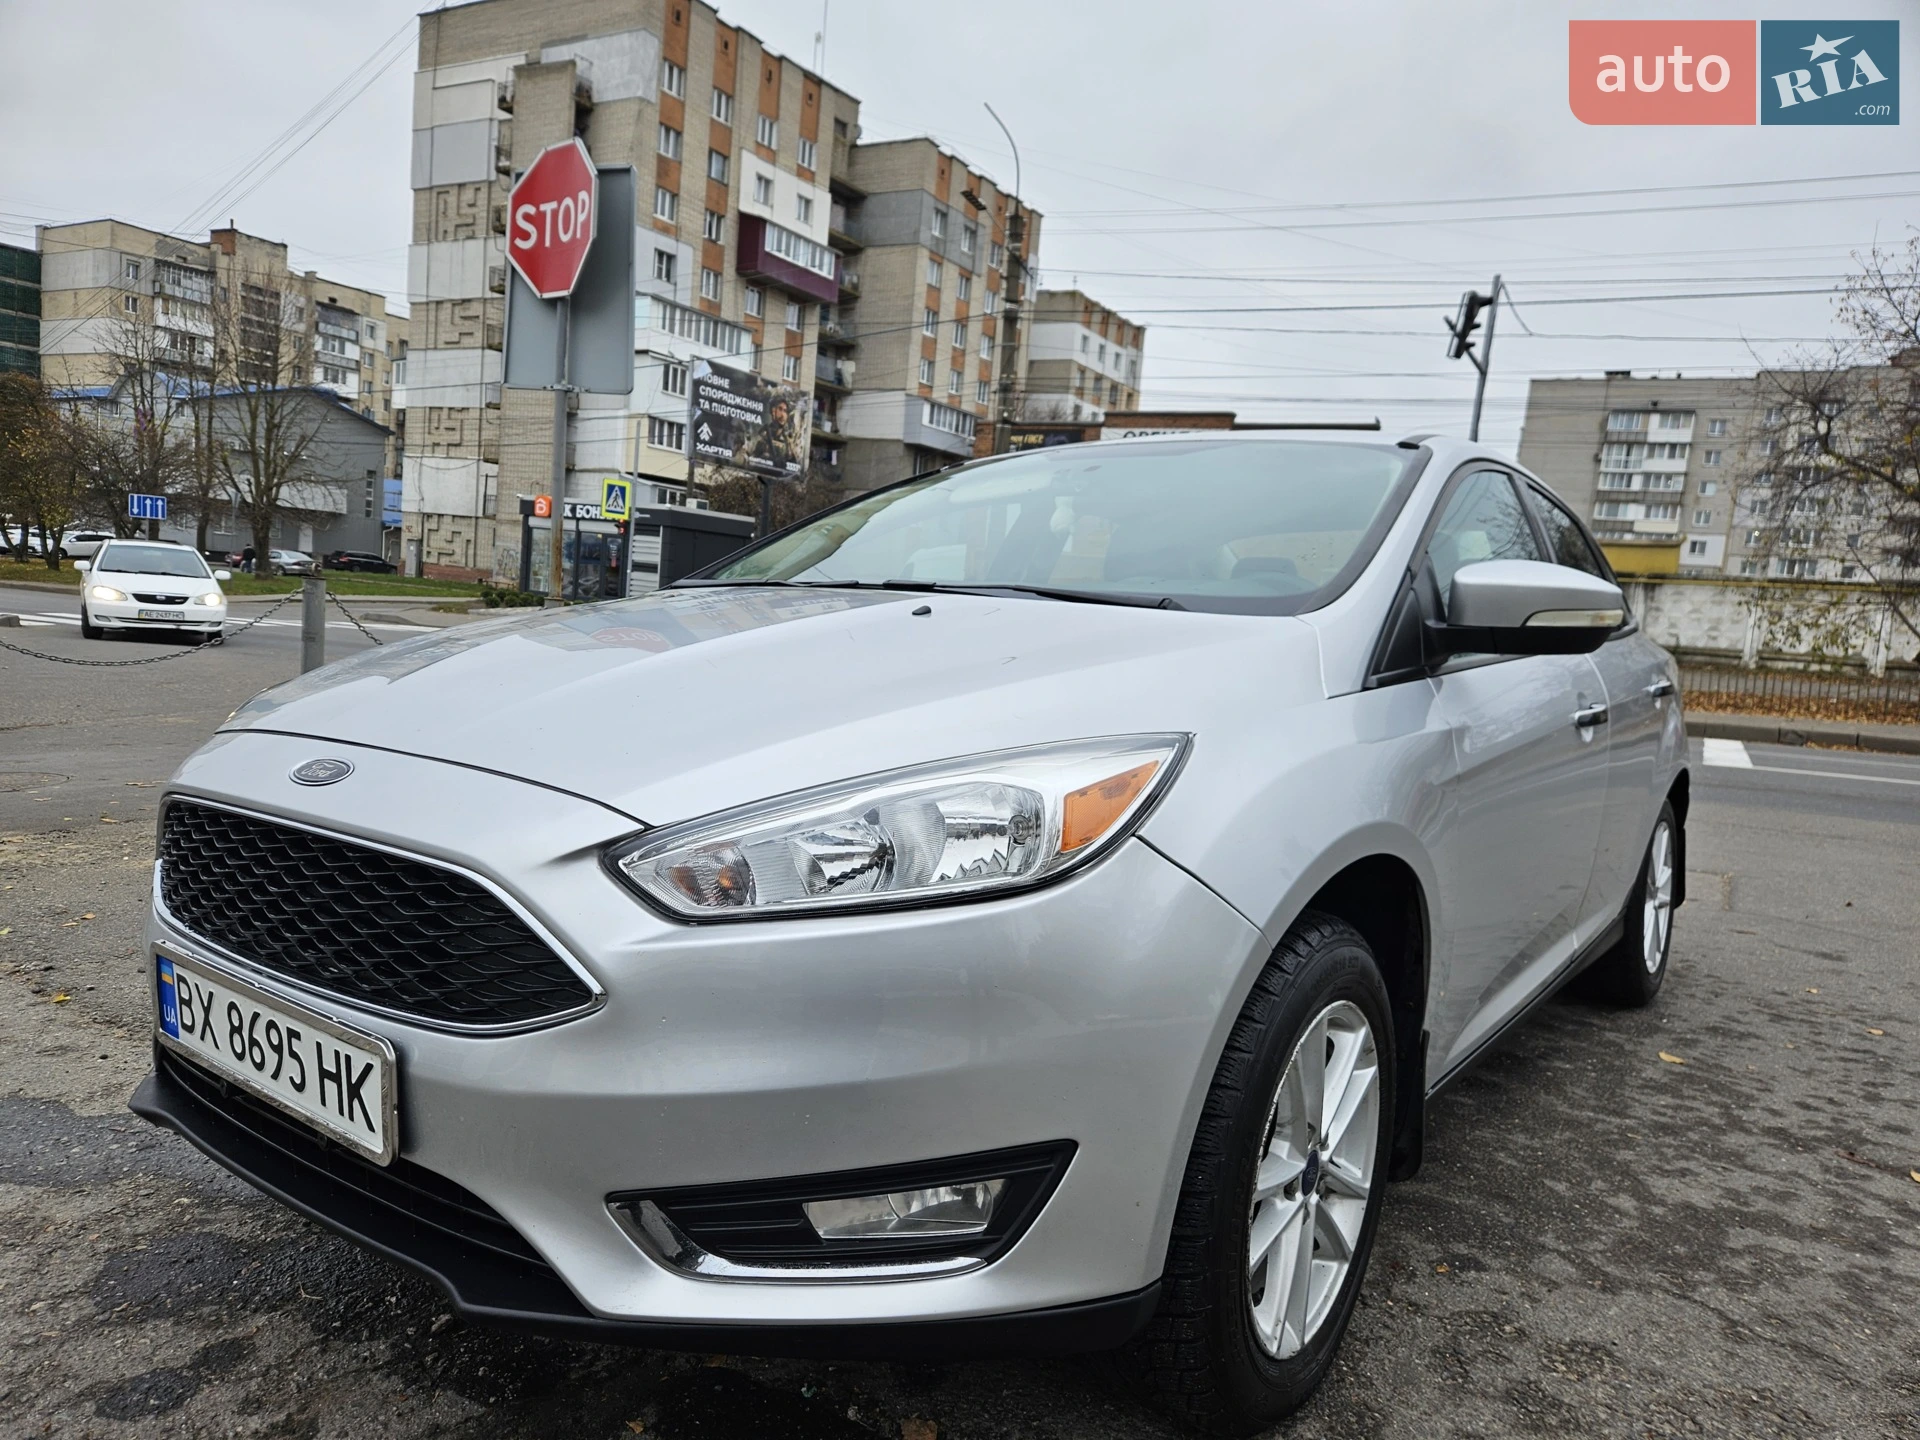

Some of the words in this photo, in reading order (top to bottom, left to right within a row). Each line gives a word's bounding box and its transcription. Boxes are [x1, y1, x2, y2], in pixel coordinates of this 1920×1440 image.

[514, 190, 590, 249] STOP
[699, 385, 764, 412] СПОРЯДЖЕННЯ
[699, 398, 710, 410] ТА
[711, 402, 763, 425] ПІДГОТОВКА
[301, 762, 338, 778] Ford
[163, 1003, 178, 1026] UA
[176, 972, 220, 1050] BX
[226, 1000, 307, 1094] 8695
[315, 1040, 377, 1134] HK
